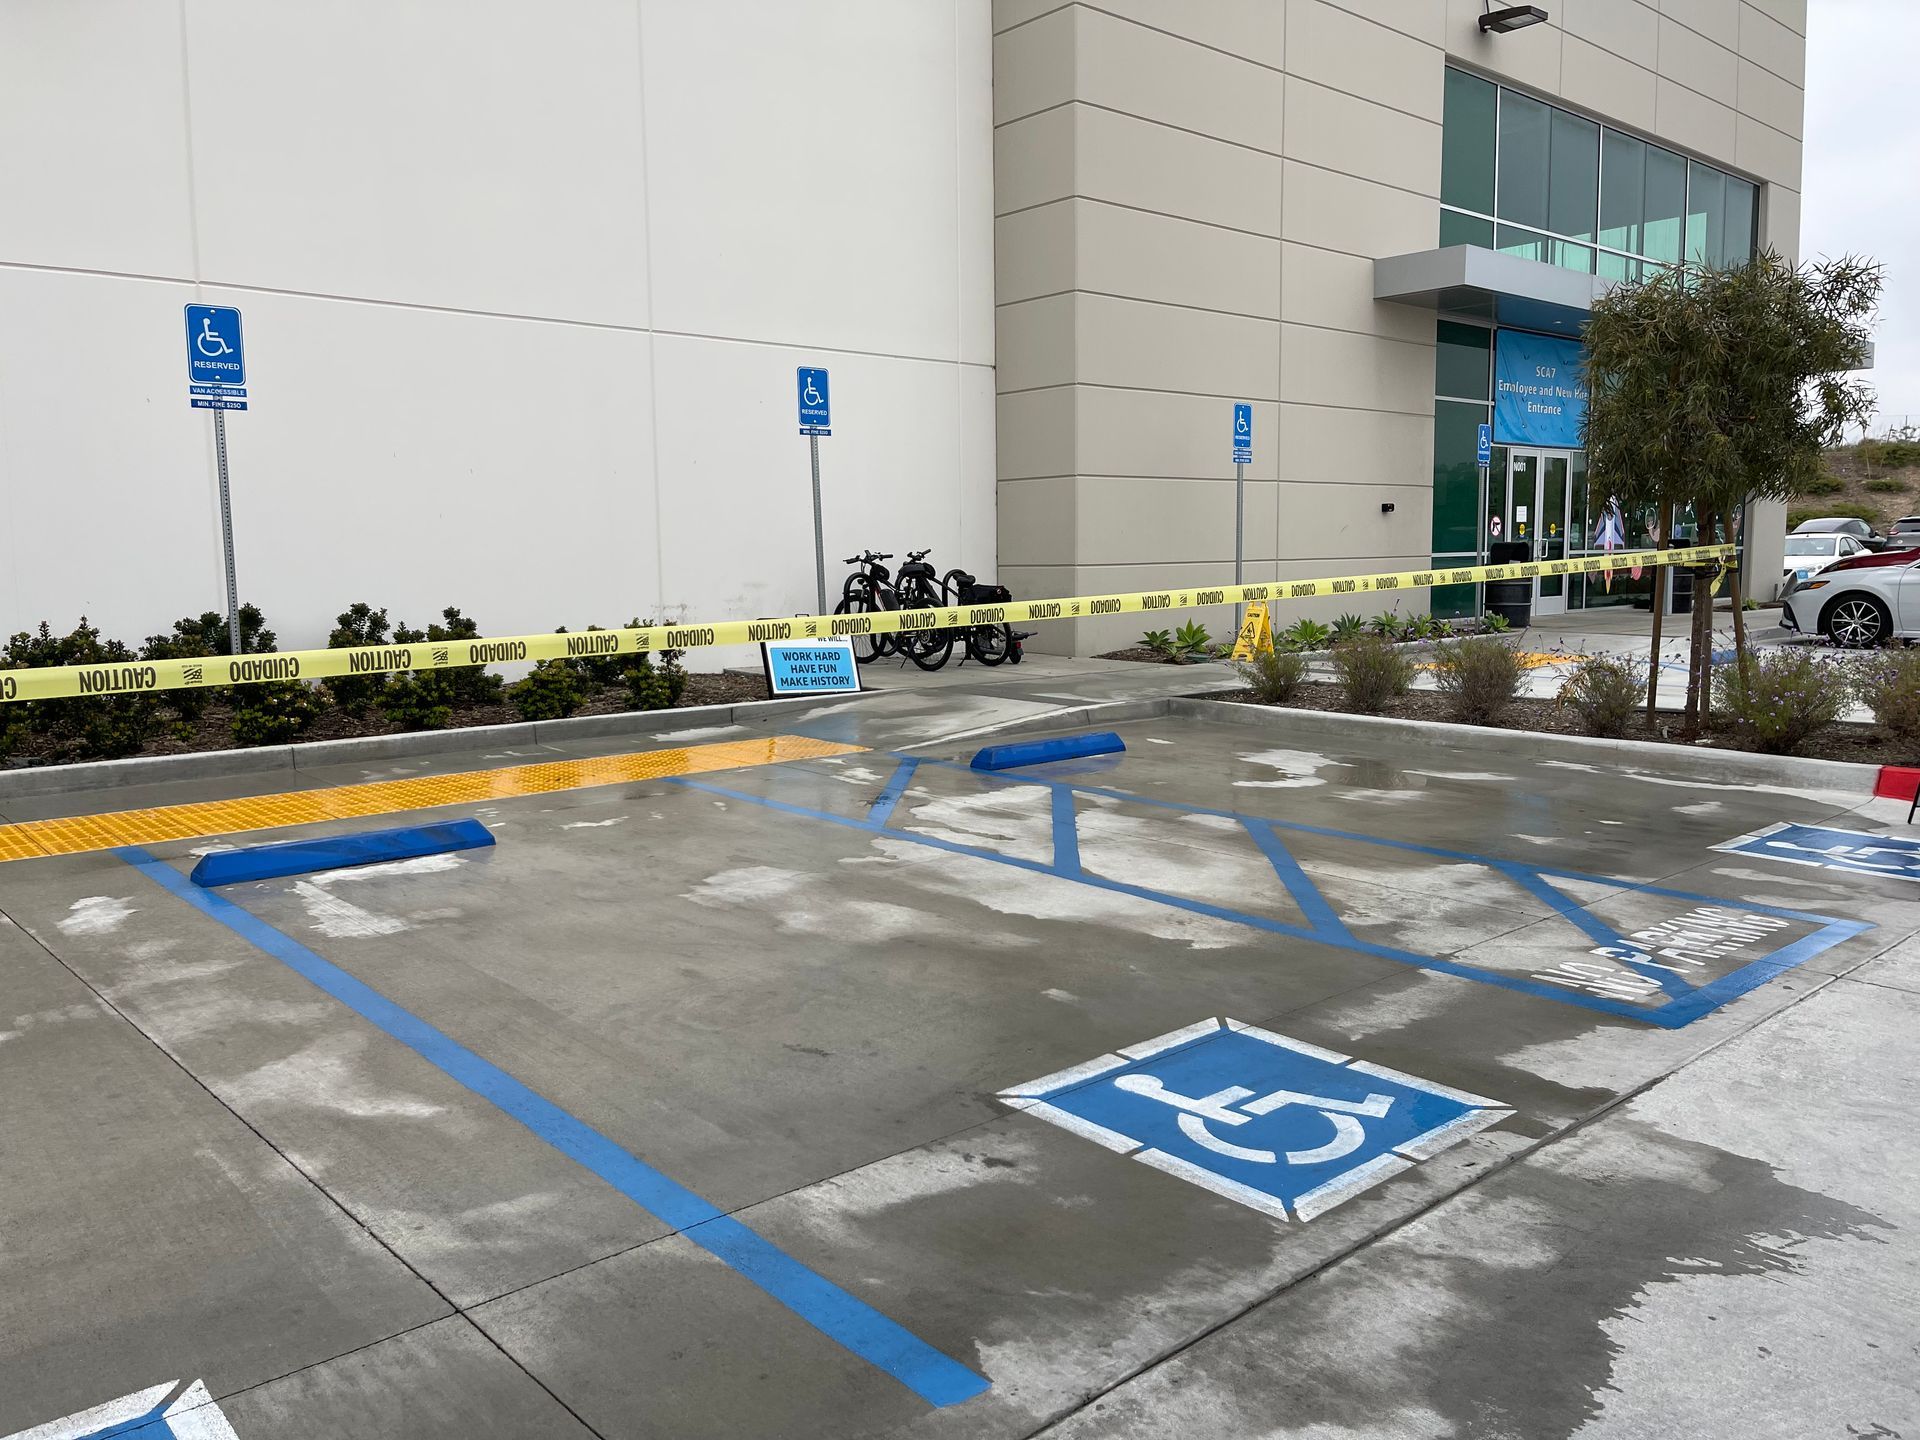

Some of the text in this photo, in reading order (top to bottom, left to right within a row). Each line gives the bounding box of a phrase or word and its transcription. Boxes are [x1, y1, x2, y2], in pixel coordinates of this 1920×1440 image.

[194, 361, 240, 370] RESERVED
[1536, 366, 1556, 378] SCA7
[206, 388, 245, 396] ACCESSIBLE
[1498, 380, 1537, 396] Employee
[1539, 386, 1553, 396] and
[1555, 386, 1573, 398] New
[1527, 402, 1562, 415] Entrance
[1513, 462, 1526, 472] N001
[1413, 573, 1434, 587] CAUTION
[1452, 570, 1473, 584] CUIDADO
[1485, 567, 1504, 580] CAUTION
[1291, 583, 1316, 597] CUIDADO
[1332, 579, 1356, 593] CAUTION
[1376, 576, 1399, 590] CUIDADO
[1196, 590, 1224, 605] CUIDADO
[1243, 586, 1268, 601] CAUTION
[1091, 598, 1121, 615] CUIDADO
[1142, 594, 1171, 610] CAUTION
[970, 607, 1005, 625] CUIDADO
[1028, 602, 1061, 619] CAUTION
[831, 617, 872, 636] CUIDADO
[900, 612, 936, 630] CAUTION
[667, 628, 715, 649] CUIDADO
[748, 622, 791, 642] CAUTION
[469, 641, 527, 664] CUIDADO
[567, 634, 619, 656] CAUTION
[349, 649, 412, 673] CAUTION
[782, 651, 841, 661] WORK HARD
[229, 656, 300, 683] CUIDADO
[790, 664, 837, 674] HAVE FUN
[78, 666, 157, 693] CAUTION
[780, 675, 850, 687] MAKE HISTORY
[1530, 907, 1790, 1001] NO PARKING
